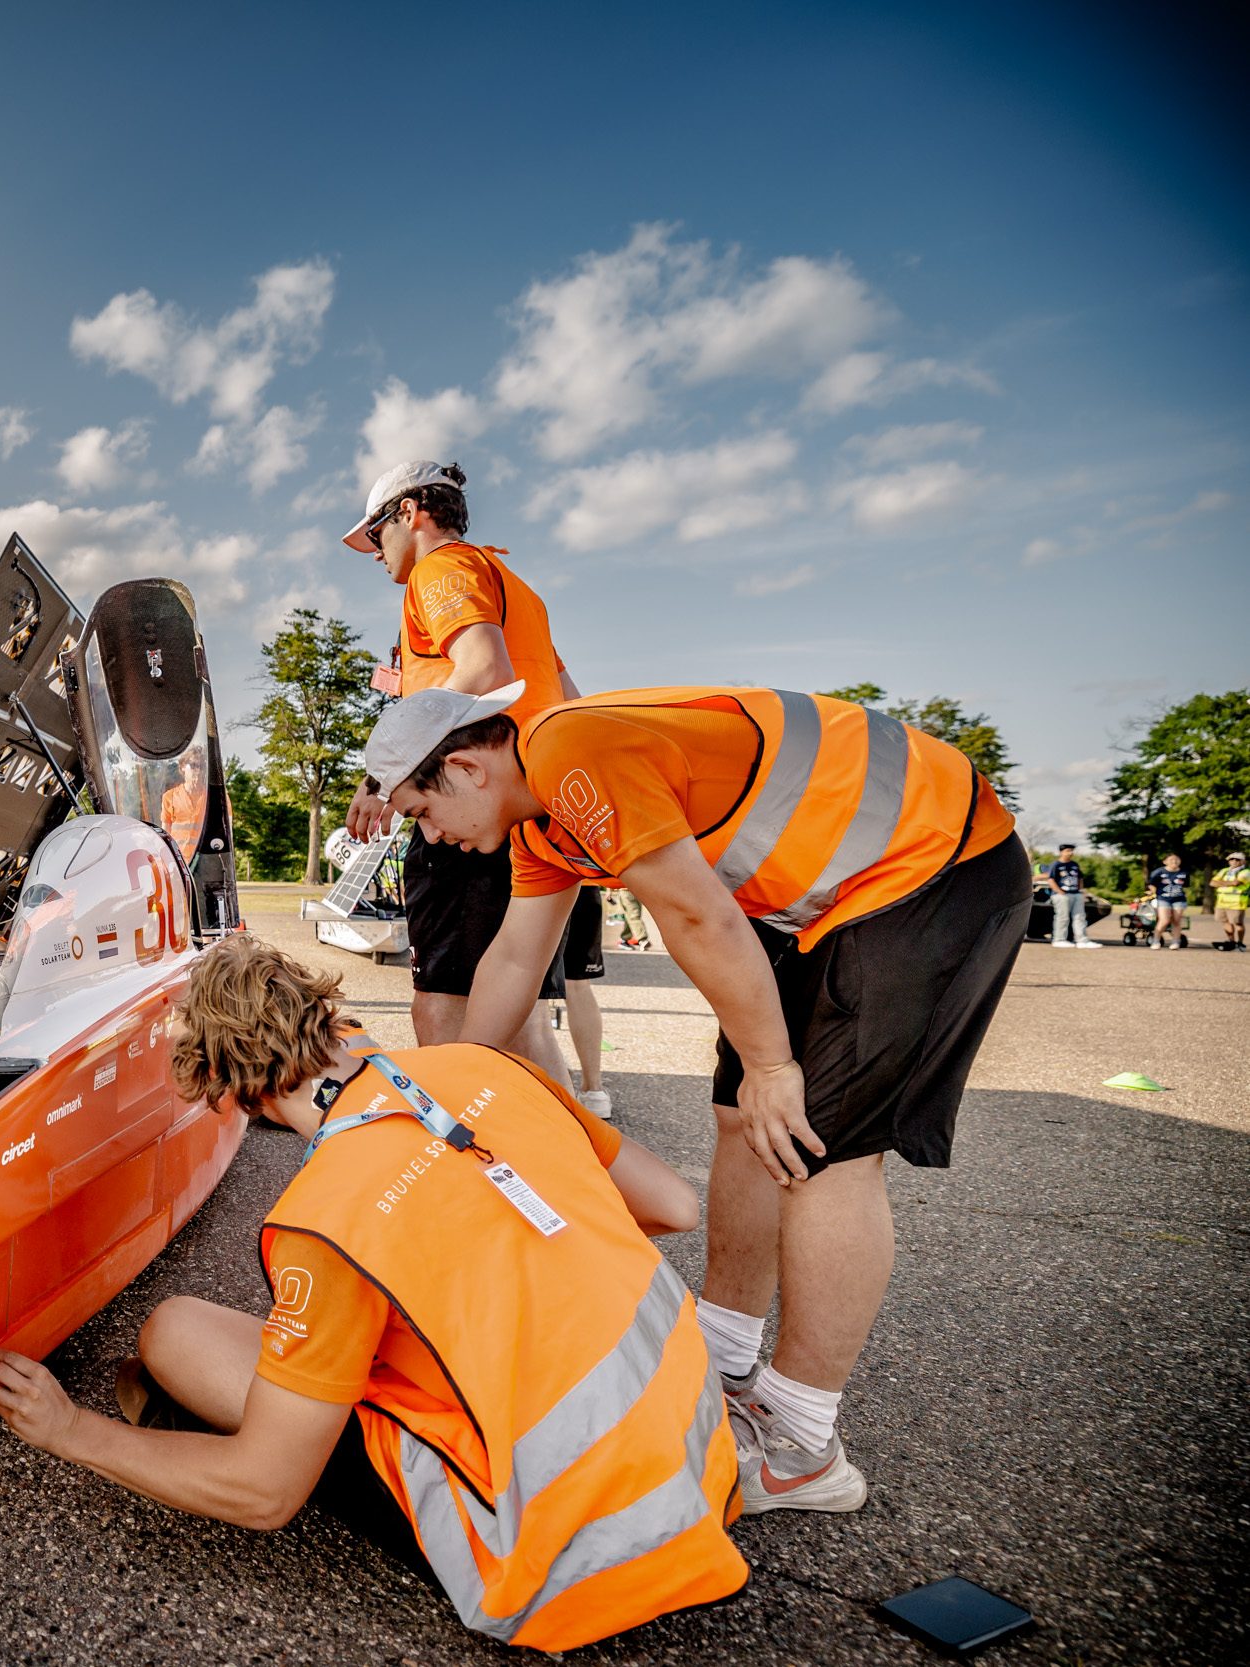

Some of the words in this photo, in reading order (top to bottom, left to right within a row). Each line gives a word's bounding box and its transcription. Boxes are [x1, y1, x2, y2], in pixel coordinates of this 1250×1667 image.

[422, 571, 466, 612] 30
[335, 845, 351, 865] 86
[126, 849, 189, 968] 30
[41, 955, 57, 966] SOLAR
[58, 953, 71, 961] TEAM
[53, 941, 69, 951] DELFT
[46, 1095, 83, 1126] omnimark
[1, 1132, 36, 1166] circet
[376, 1155, 431, 1214] BRUNEL
[459, 1087, 497, 1124] TEAM
[287, 1318, 307, 1331] TEAM
